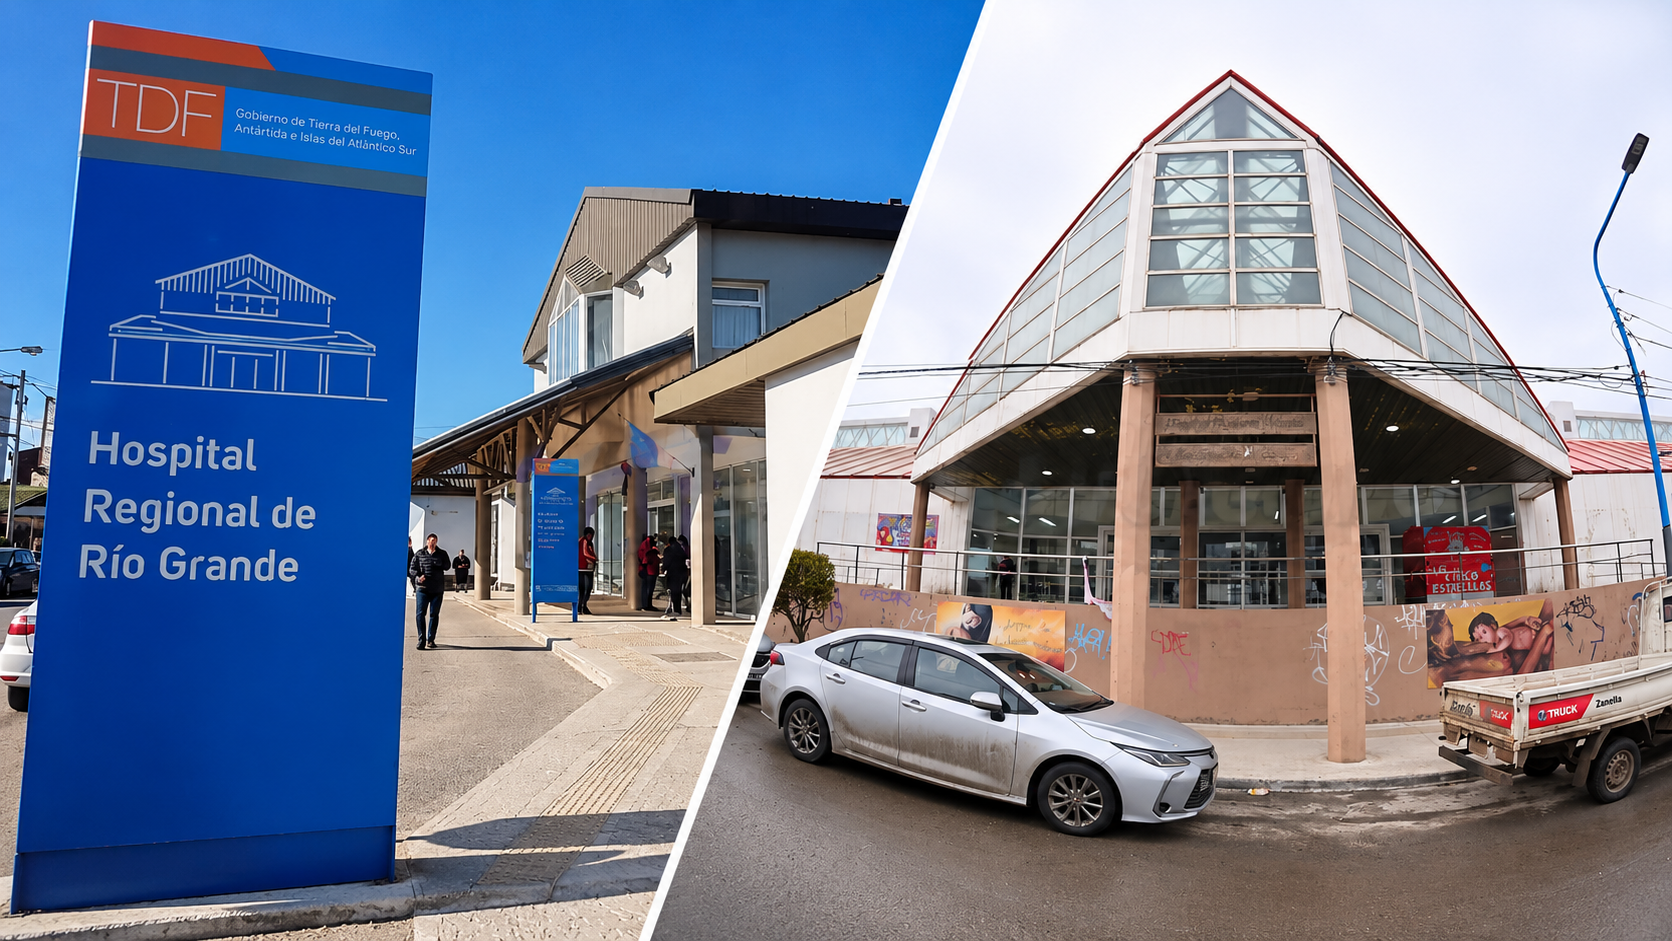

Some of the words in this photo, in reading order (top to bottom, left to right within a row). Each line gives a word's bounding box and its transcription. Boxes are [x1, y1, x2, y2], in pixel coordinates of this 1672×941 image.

[97, 78, 217, 137] TDF
[235, 108, 288, 125] Gobierno
[291, 116, 306, 128] de
[308, 118, 341, 132] Tierra
[344, 123, 361, 134] del
[234, 123, 287, 140] Antártida
[290, 132, 298, 141] e
[300, 131, 326, 144] Islas
[328, 136, 345, 147] del
[347, 138, 396, 153] Atlántico
[398, 145, 417, 156] Sur
[88, 430, 257, 477] Hospital
[83, 488, 260, 534] Regional
[271, 496, 316, 530] de
[78, 544, 146, 580] Río
[159, 546, 299, 583] Grande
[1547, 704, 1578, 719] TRUCK
